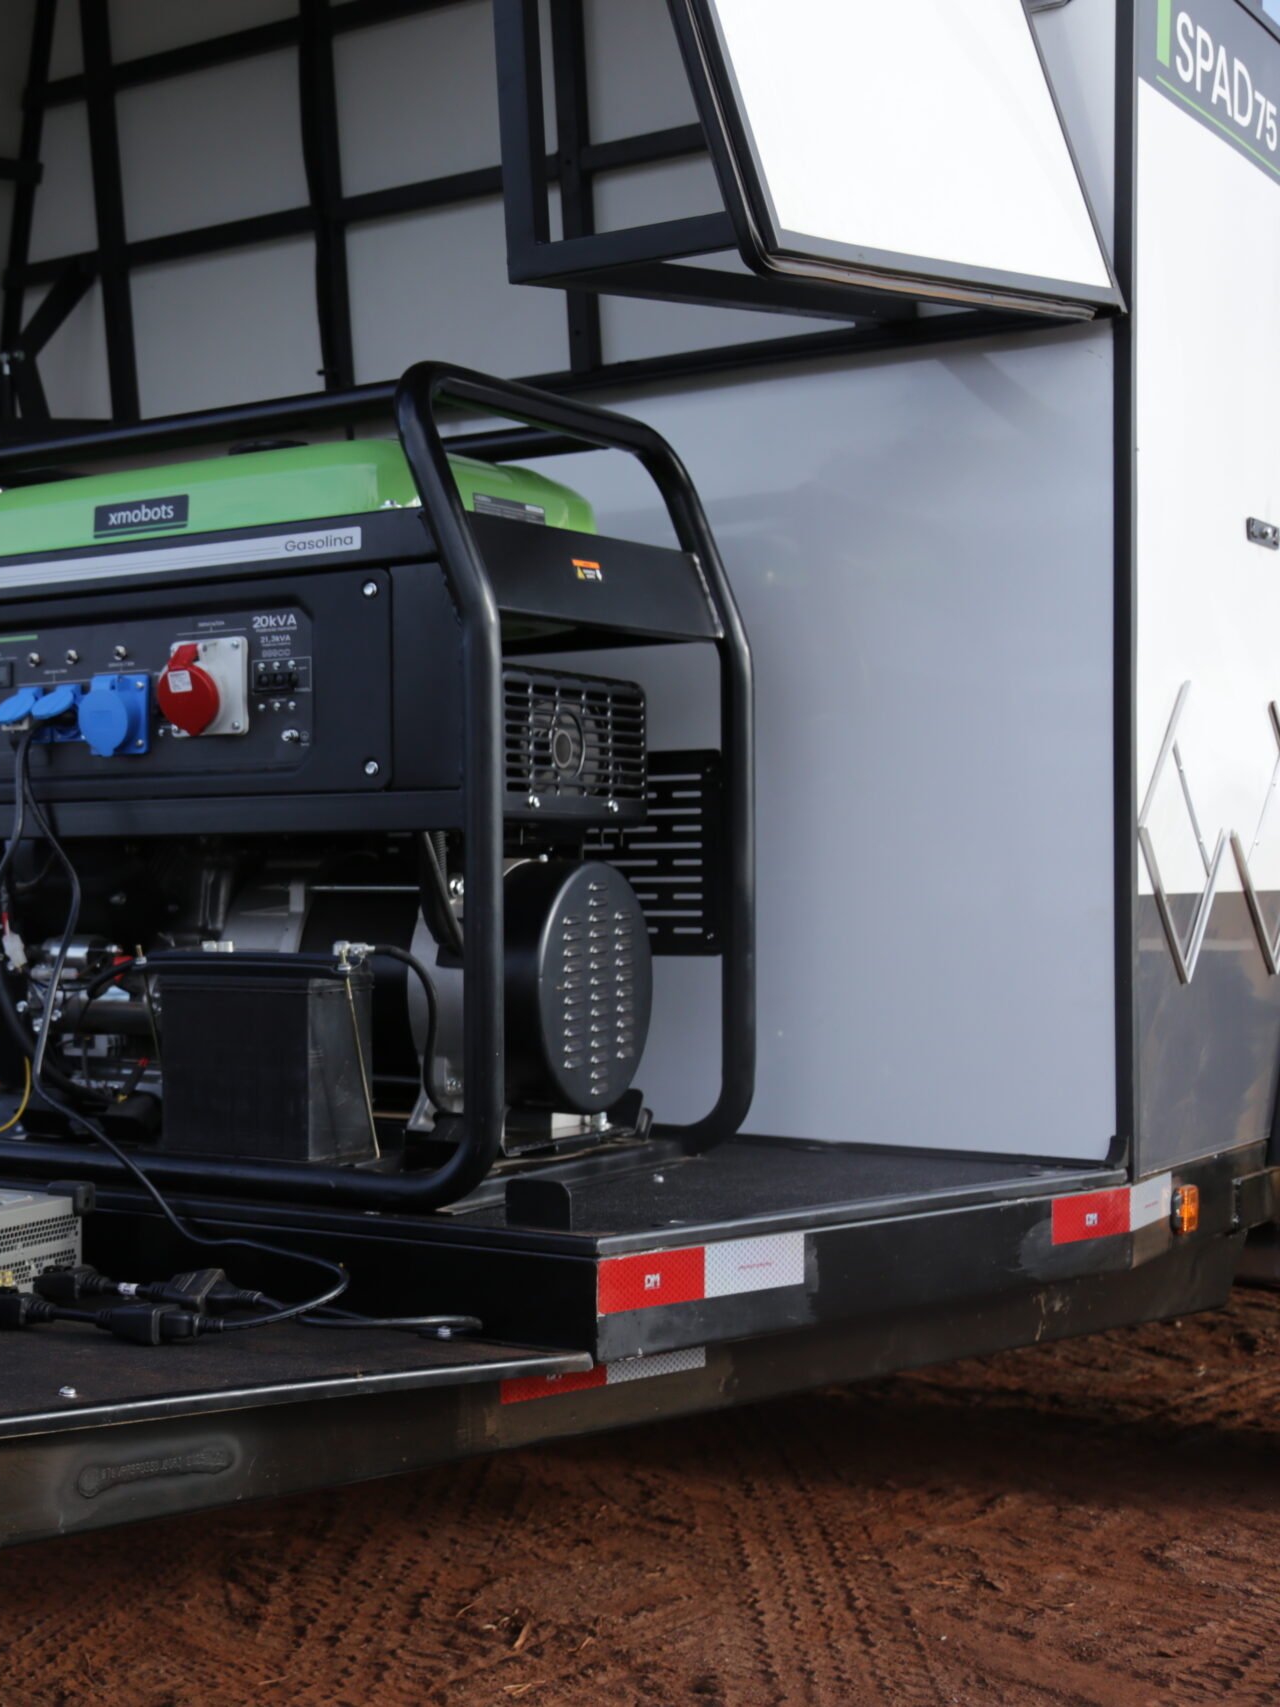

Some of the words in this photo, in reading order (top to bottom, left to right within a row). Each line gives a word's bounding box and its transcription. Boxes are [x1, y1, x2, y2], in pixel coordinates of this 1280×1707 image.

[108, 504, 175, 526] xmobots
[284, 534, 354, 552] Gasolina
[252, 614, 297, 629] 20kVA
